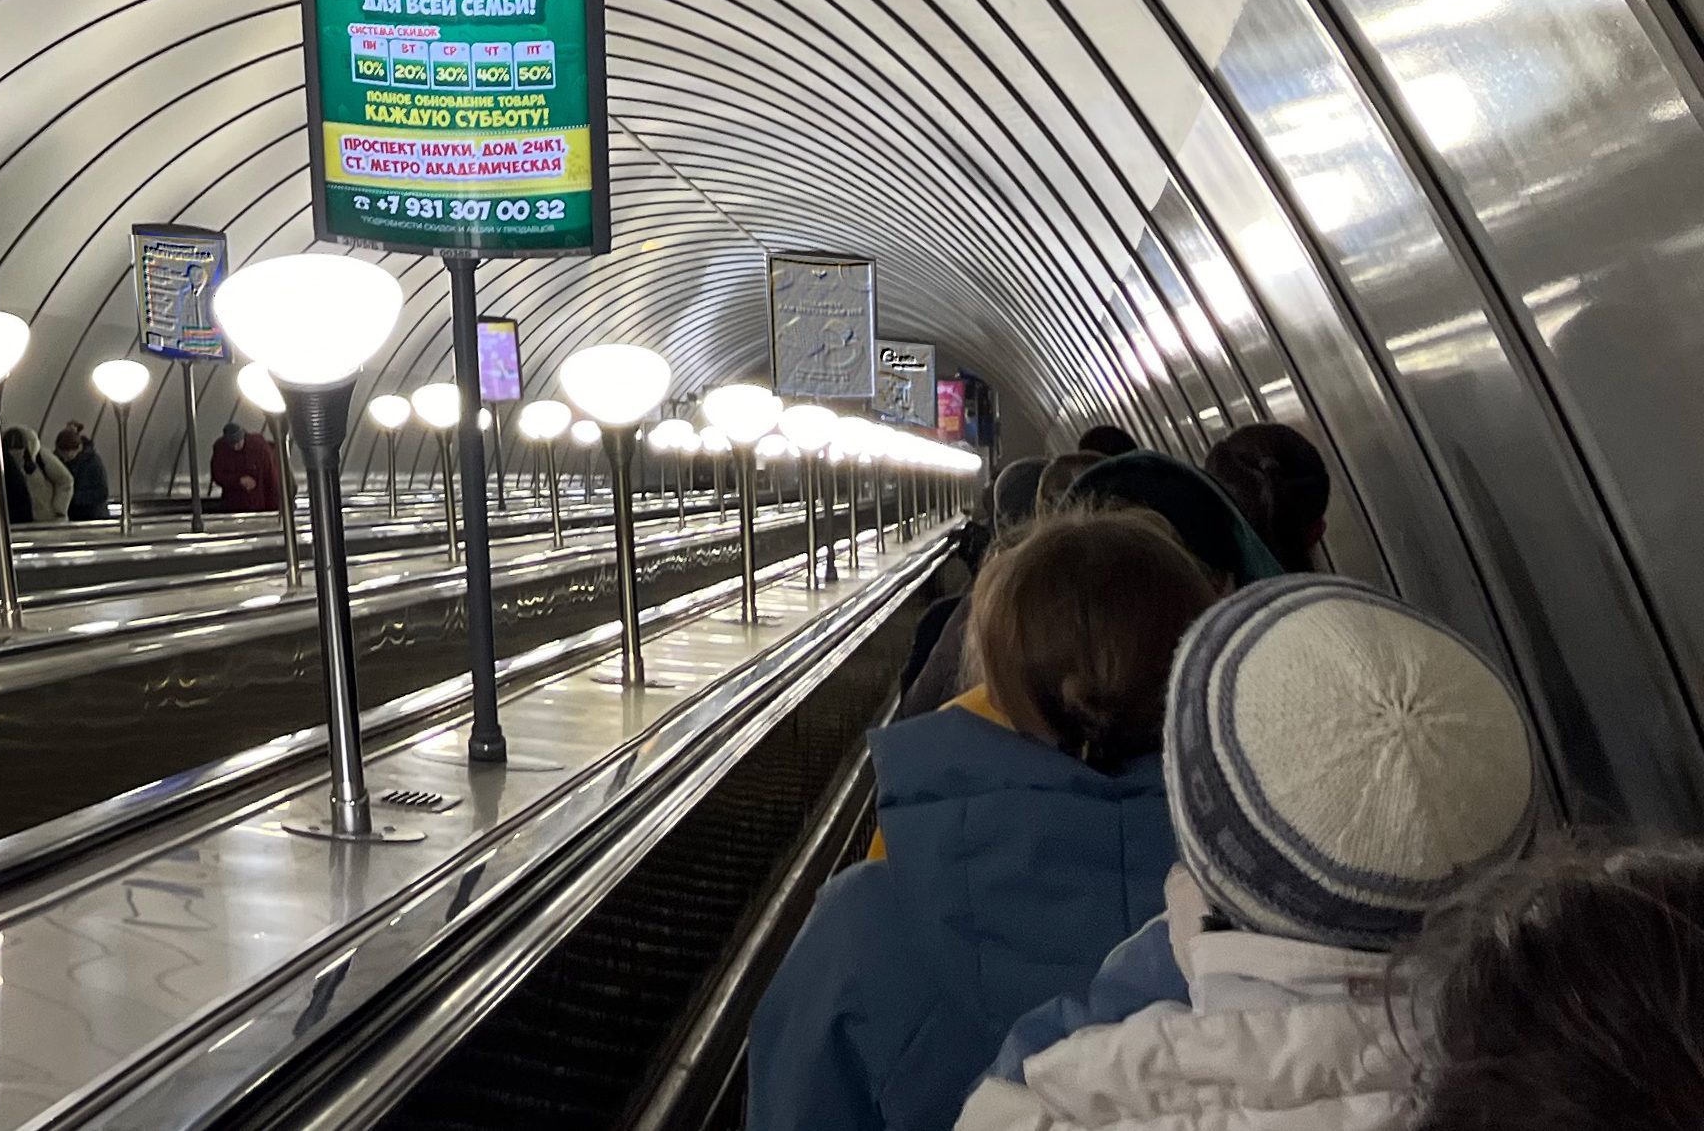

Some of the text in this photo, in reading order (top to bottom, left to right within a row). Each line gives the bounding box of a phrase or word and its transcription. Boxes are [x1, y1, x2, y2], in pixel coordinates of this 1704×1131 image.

[350, 25, 438, 38] СИСТЕМА СКИДОК
[401, 44, 416, 54] ВТ
[443, 46, 457, 56] СР
[484, 46, 500, 56] ЧТ
[526, 45, 542, 55] ПТ
[357, 60, 385, 77] 10%
[394, 64, 427, 80] 20%
[436, 66, 468, 82] 30%
[476, 66, 510, 82] 40%
[519, 65, 552, 81] 50%
[366, 91, 546, 107] ПОЛНОЕ ОБНОВЛЕНИЕ ТОВАРА
[365, 105, 550, 128] КАЖДУЮ СУББОТУ!
[344, 137, 565, 159] ПРОСПЕКТ НАУКИ, ДОМ 24К1,
[345, 156, 562, 176] СТ. МЕТРО АКАДЕМИЧЕСКАЯ
[376, 195, 566, 221] +7 931 307 00 32
